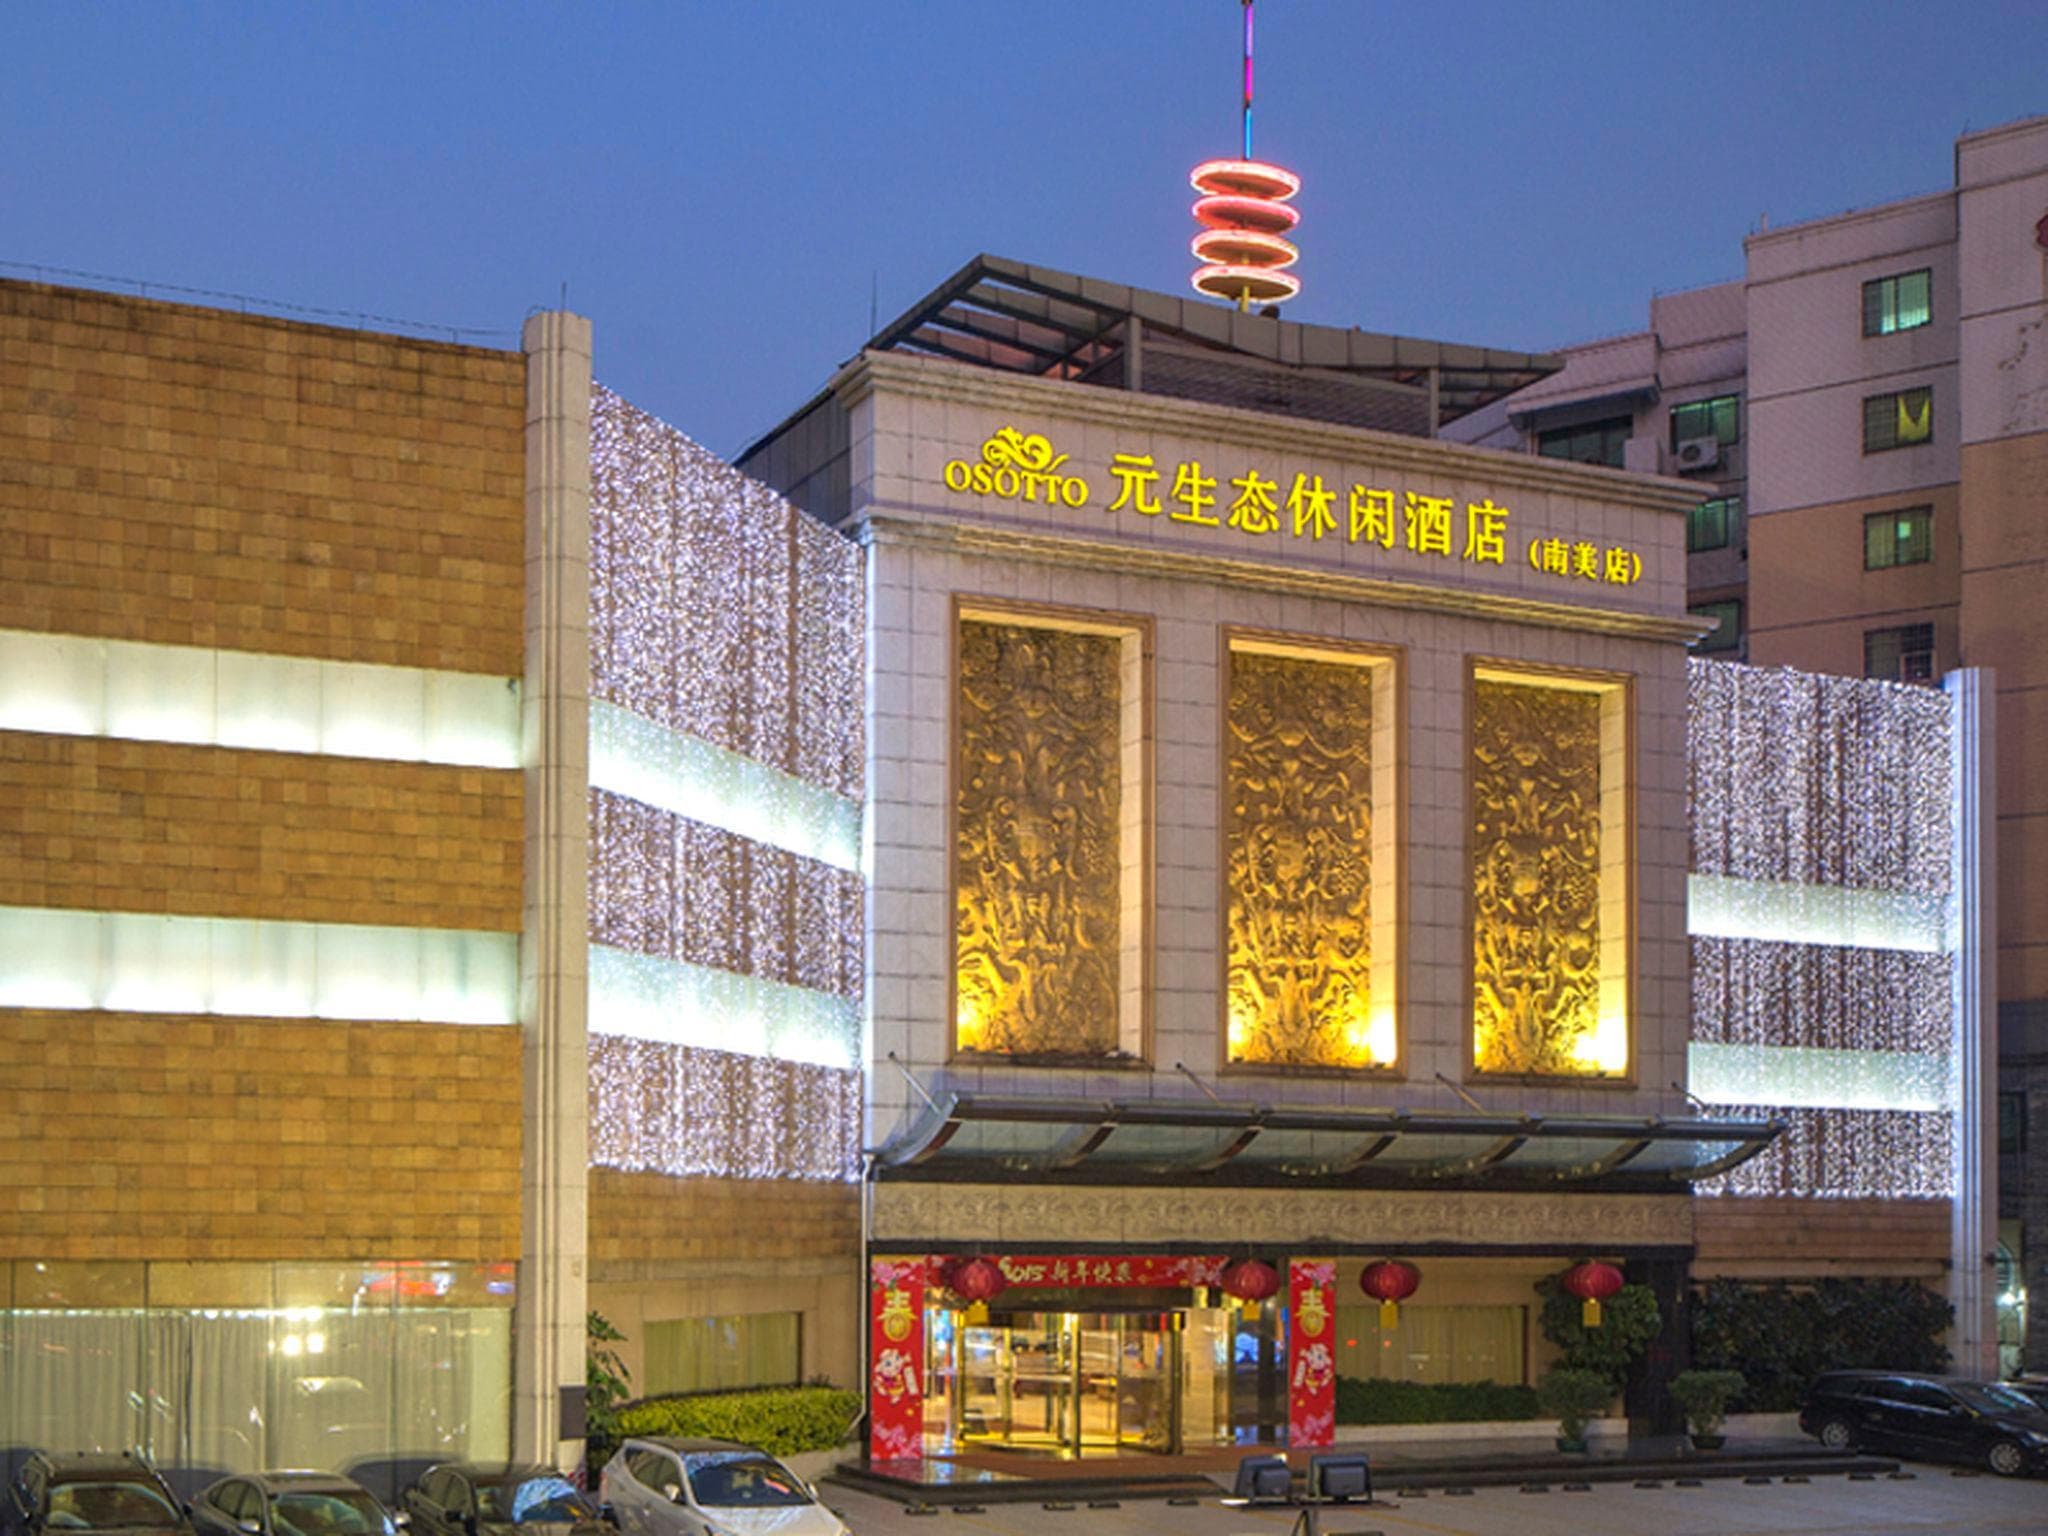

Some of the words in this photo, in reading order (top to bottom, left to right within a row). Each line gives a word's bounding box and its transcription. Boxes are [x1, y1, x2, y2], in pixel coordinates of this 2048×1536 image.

[944, 459, 1089, 508] OSOTTO
[1108, 452, 1510, 565] 元生态休闲酒店
